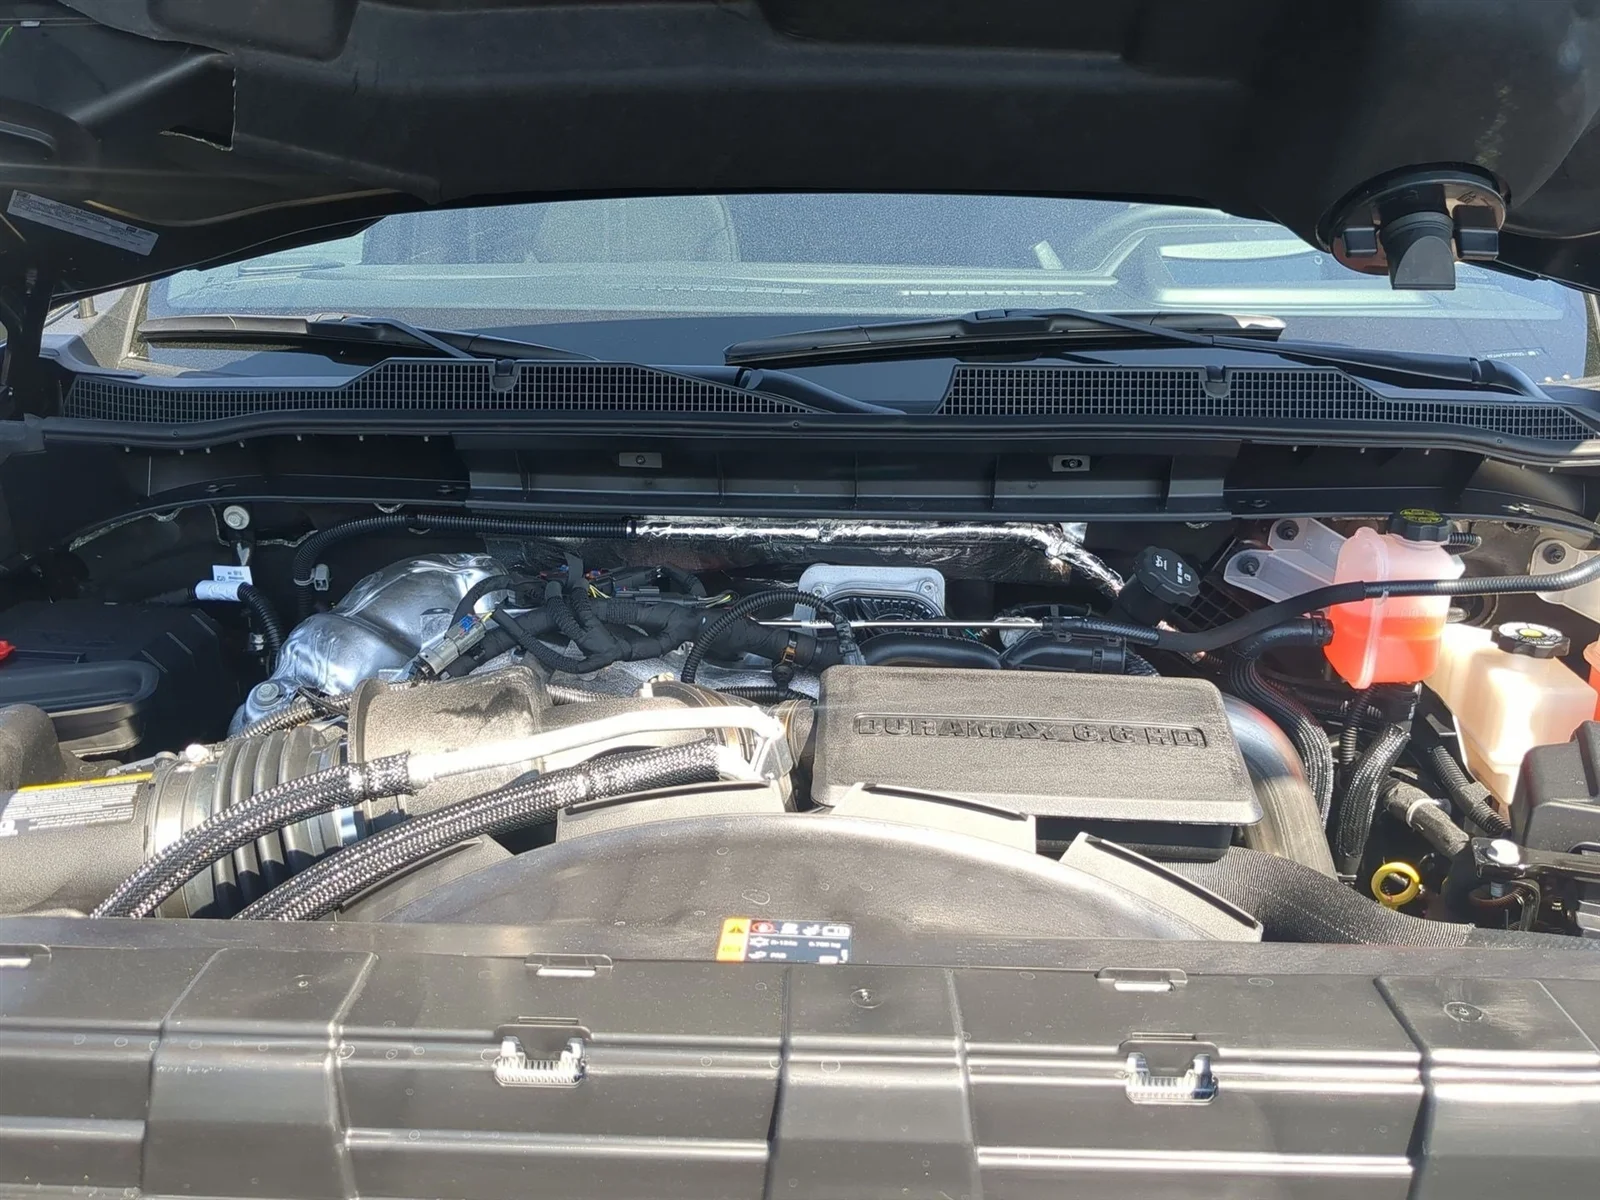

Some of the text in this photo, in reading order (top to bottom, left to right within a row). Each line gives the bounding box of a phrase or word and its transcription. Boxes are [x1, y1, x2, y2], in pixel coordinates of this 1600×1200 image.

[857, 717, 1199, 747] DURAMAX 6.6 HD
